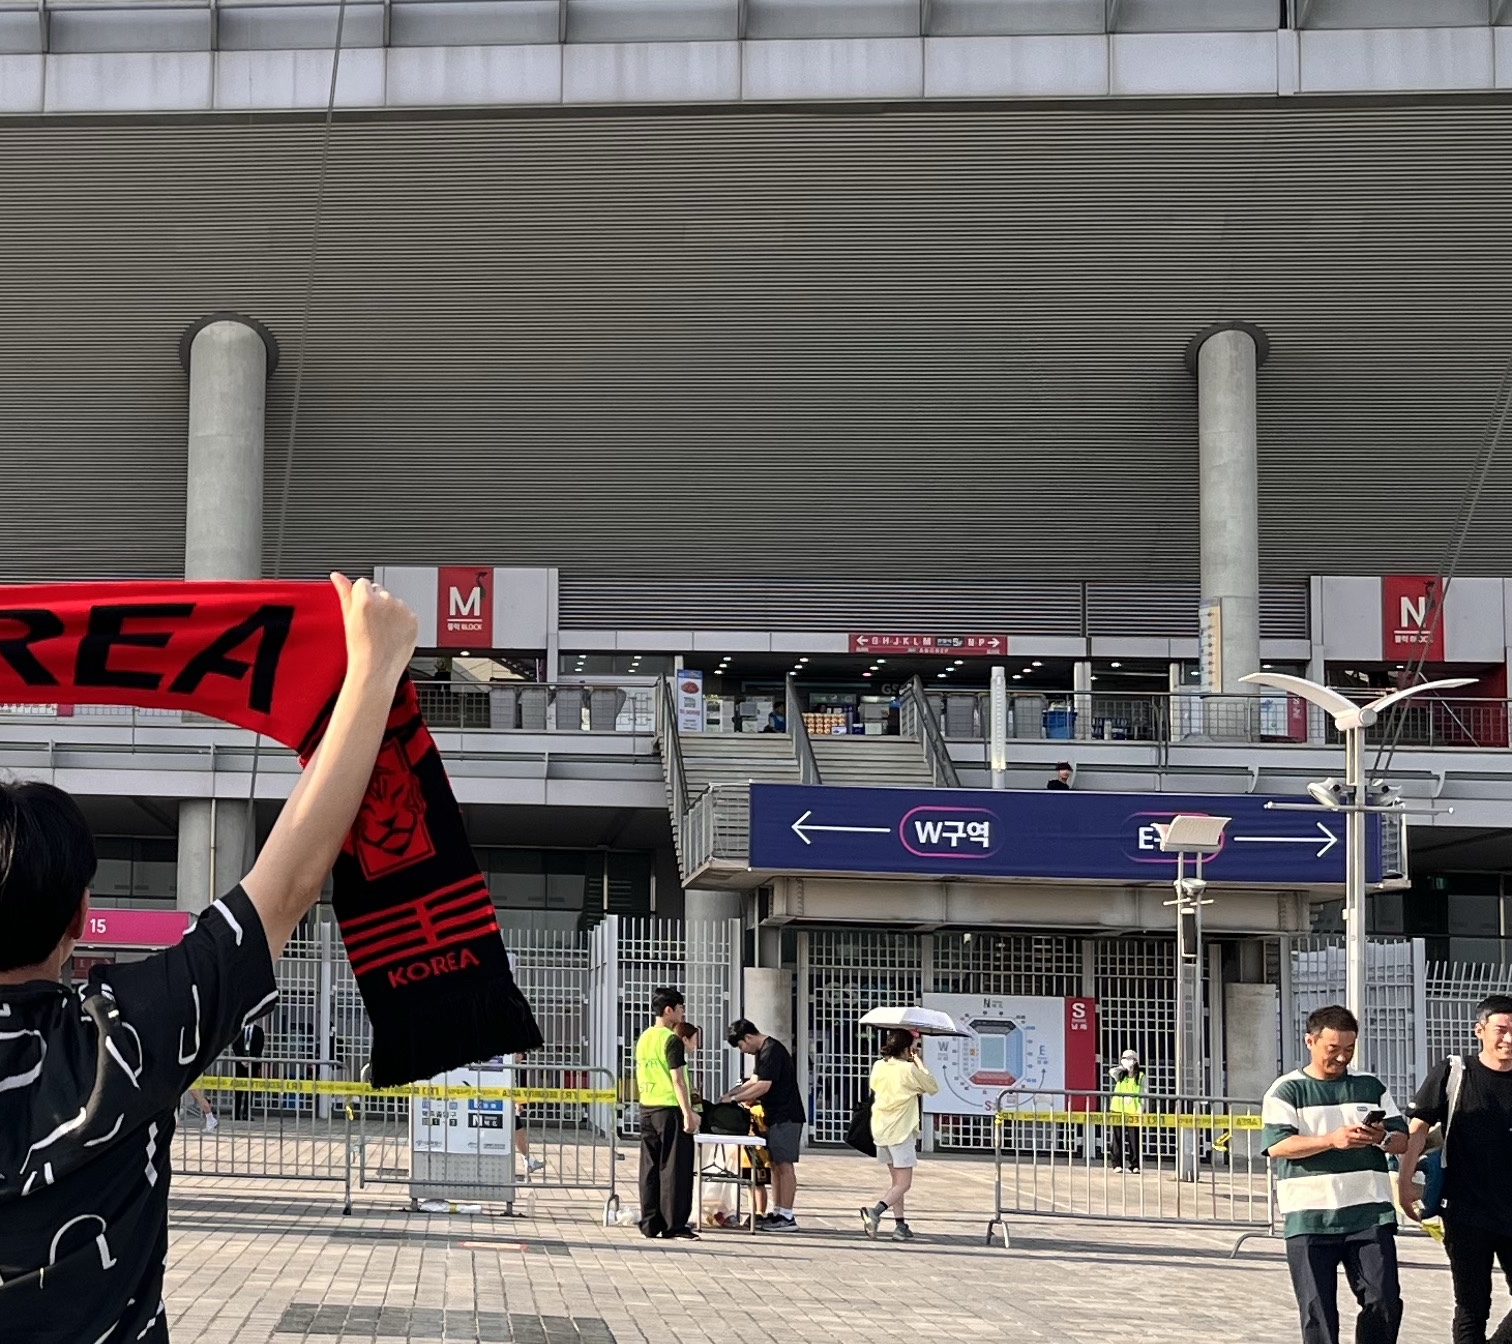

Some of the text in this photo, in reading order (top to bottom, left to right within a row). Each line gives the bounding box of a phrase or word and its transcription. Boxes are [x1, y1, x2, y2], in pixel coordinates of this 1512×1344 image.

[449, 586, 481, 616] M
[1400, 596, 1427, 628] N
[461, 623, 483, 631] BLOCK
[914, 819, 990, 849] W구역
[90, 918, 107, 934] 15
[387, 947, 481, 989] KOREA
[1071, 1002, 1086, 1019] S
